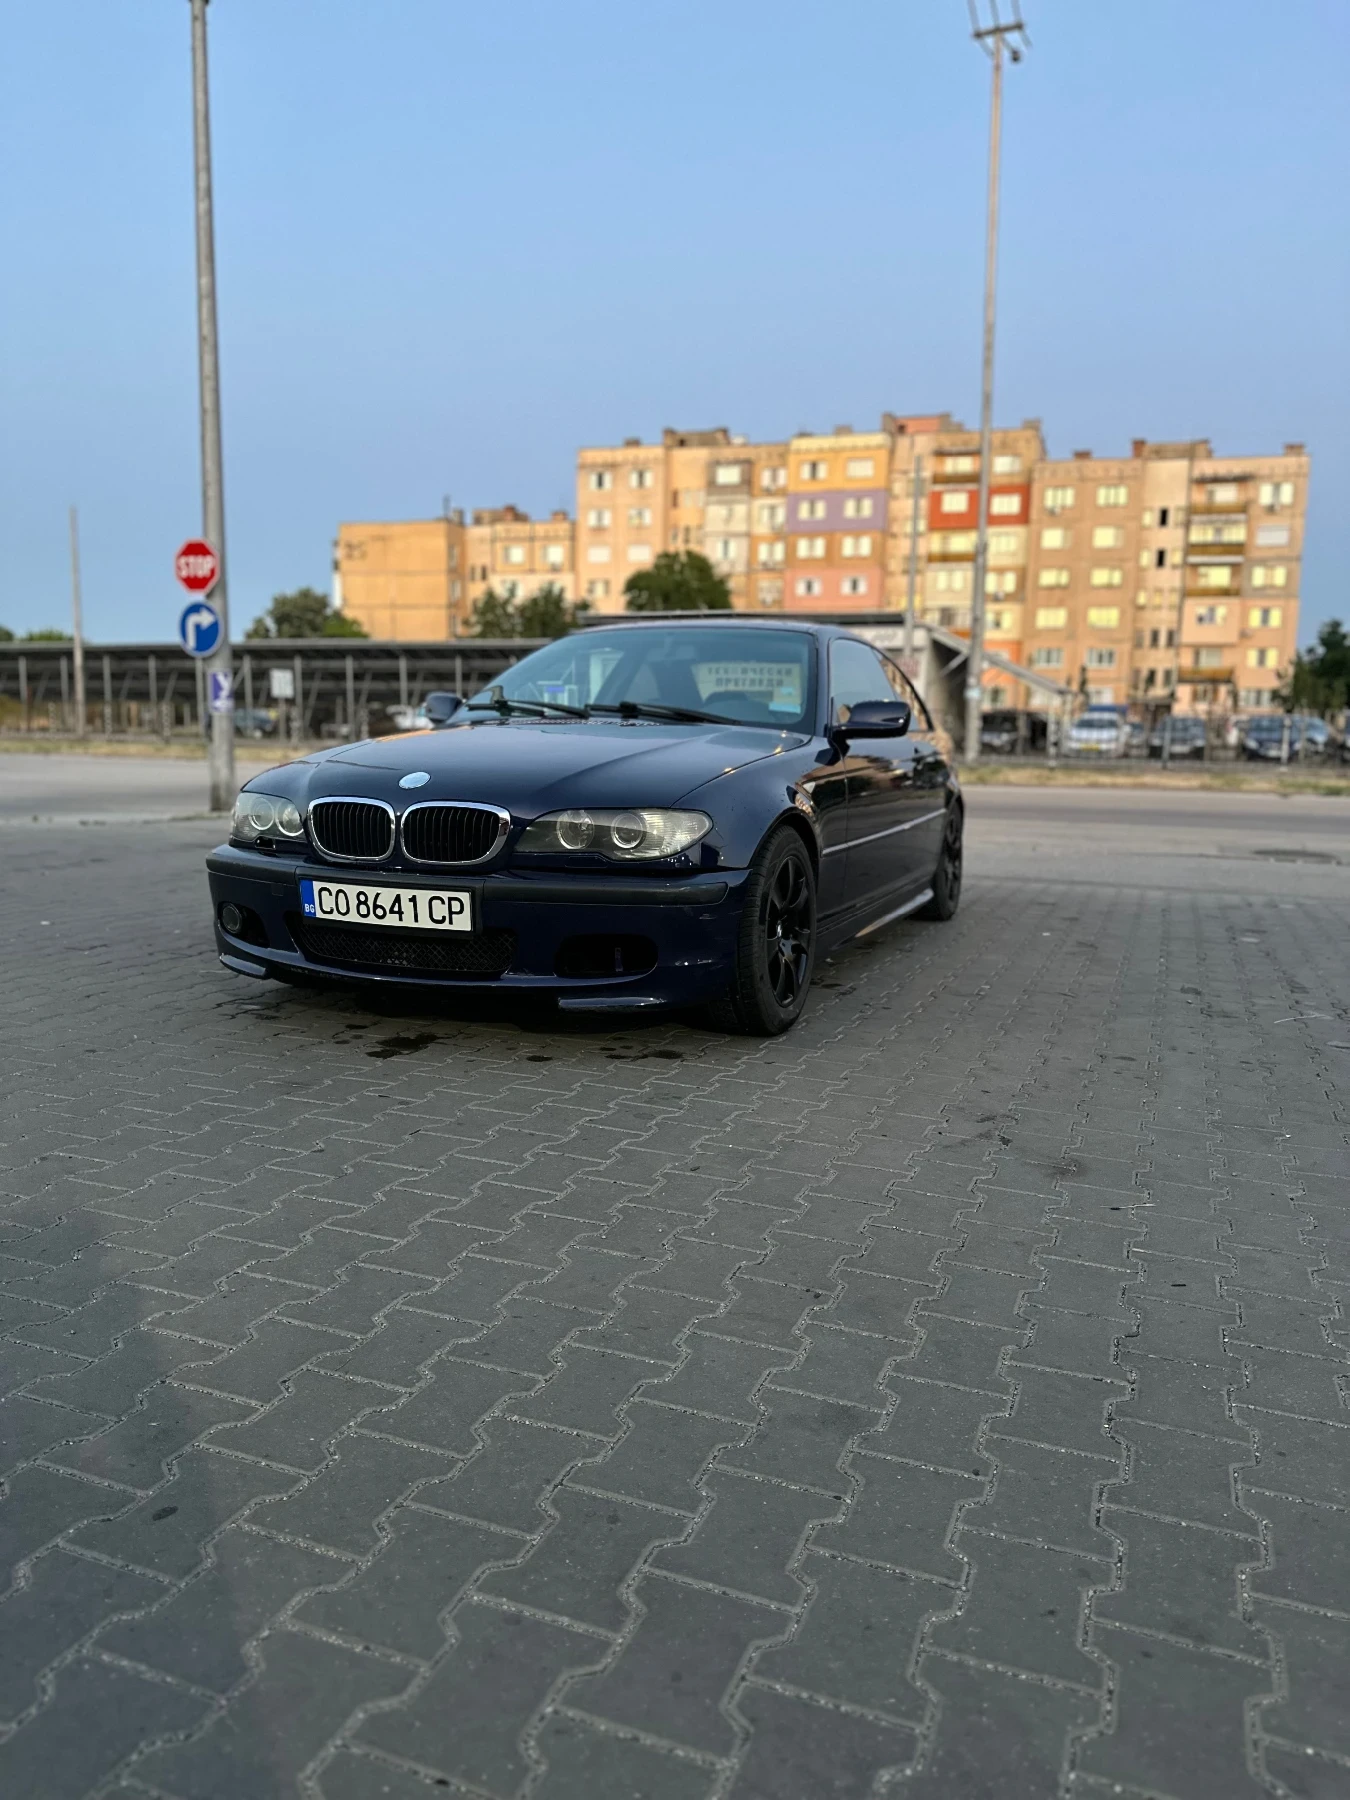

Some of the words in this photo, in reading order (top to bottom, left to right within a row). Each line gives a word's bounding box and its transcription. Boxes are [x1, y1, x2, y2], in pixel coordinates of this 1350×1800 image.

[180, 554, 213, 579] STOP
[707, 667, 793, 676] ТЕХИЧЕСКИ
[304, 903, 315, 913] BG
[318, 887, 350, 916] CO
[356, 891, 419, 923] 8641
[428, 896, 465, 925] CP
